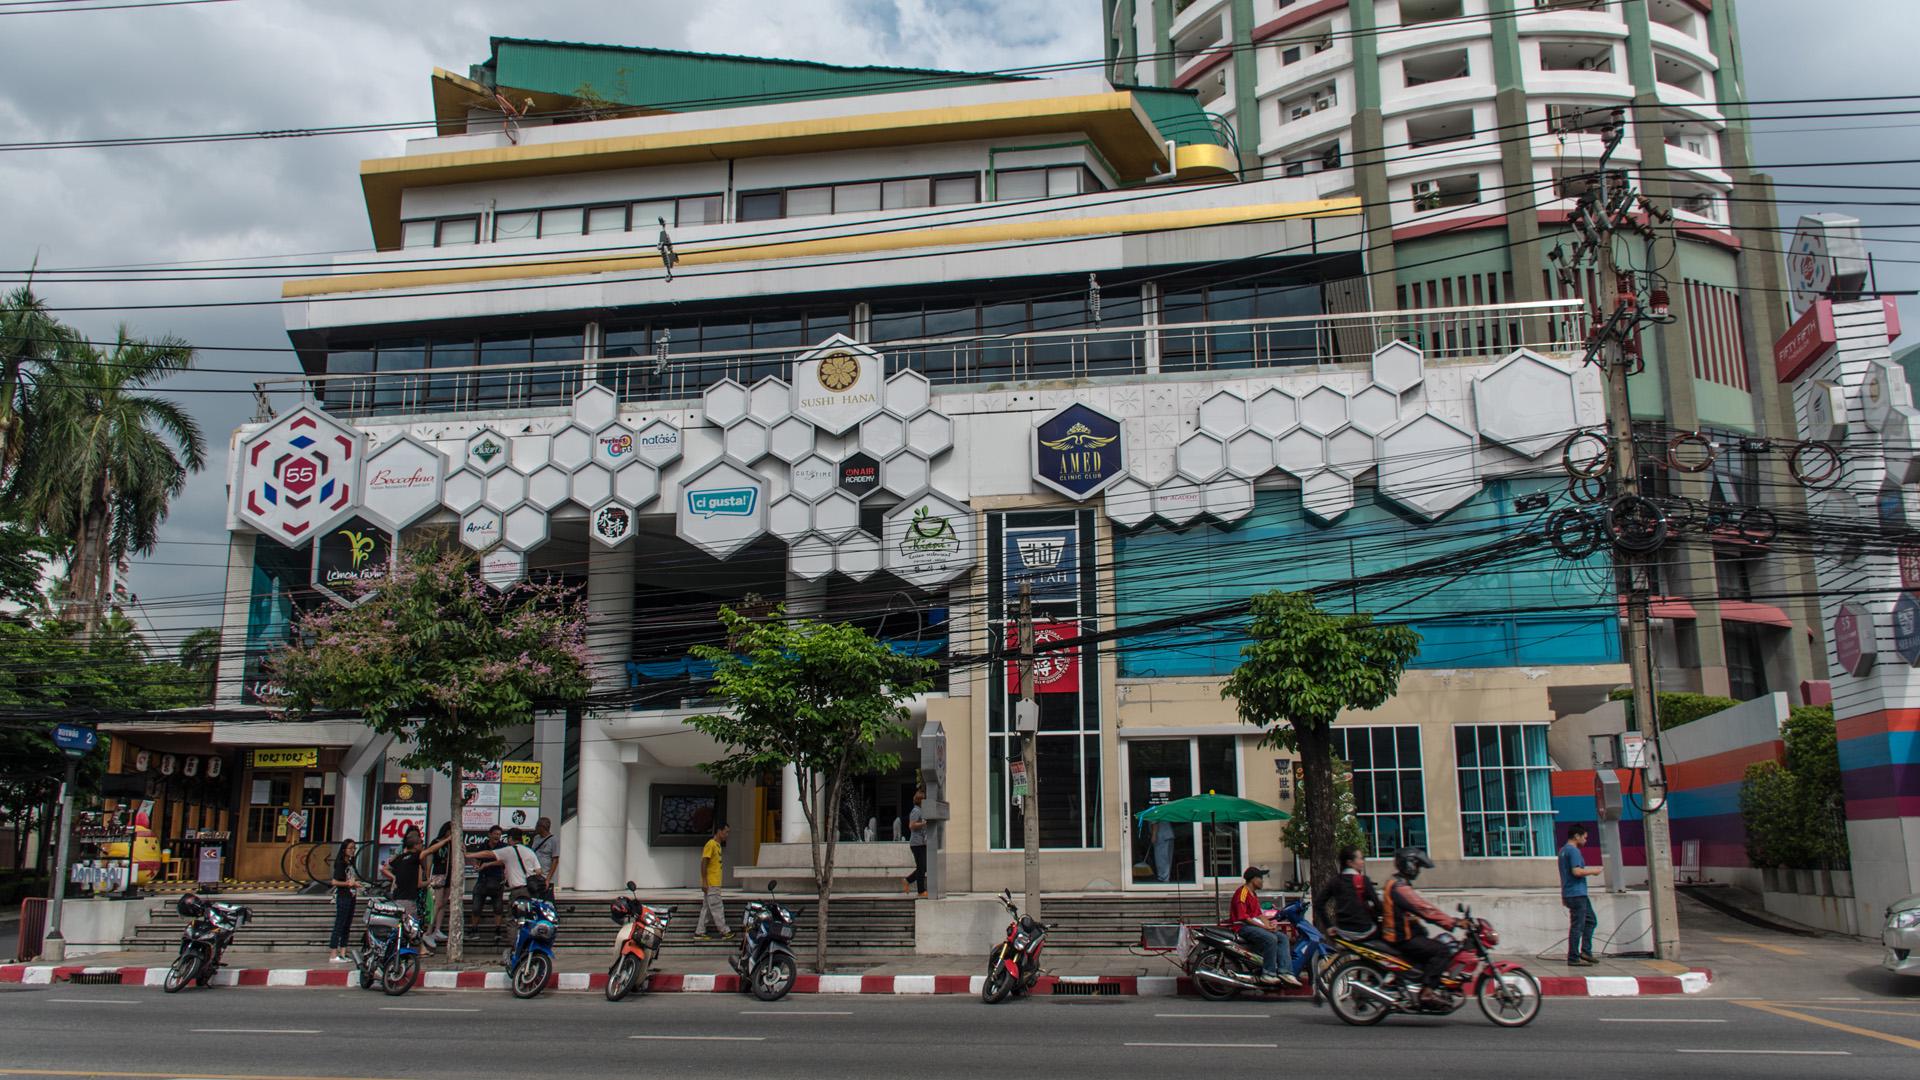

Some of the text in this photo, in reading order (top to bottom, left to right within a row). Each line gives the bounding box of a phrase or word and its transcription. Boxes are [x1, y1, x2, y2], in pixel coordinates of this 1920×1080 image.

[801, 393, 876, 408] SUSHI HANA
[286, 467, 313, 483] 55
[369, 467, 435, 487] Beccofino
[696, 494, 747, 509] ci gusta!
[466, 520, 494, 533] April
[327, 569, 358, 581] Lemon
[86, 732, 93, 744] 2
[258, 752, 304, 763] TORI TORI
[504, 765, 520, 775] TORI
[522, 765, 540, 775] TORI
[382, 818, 413, 838] 40
